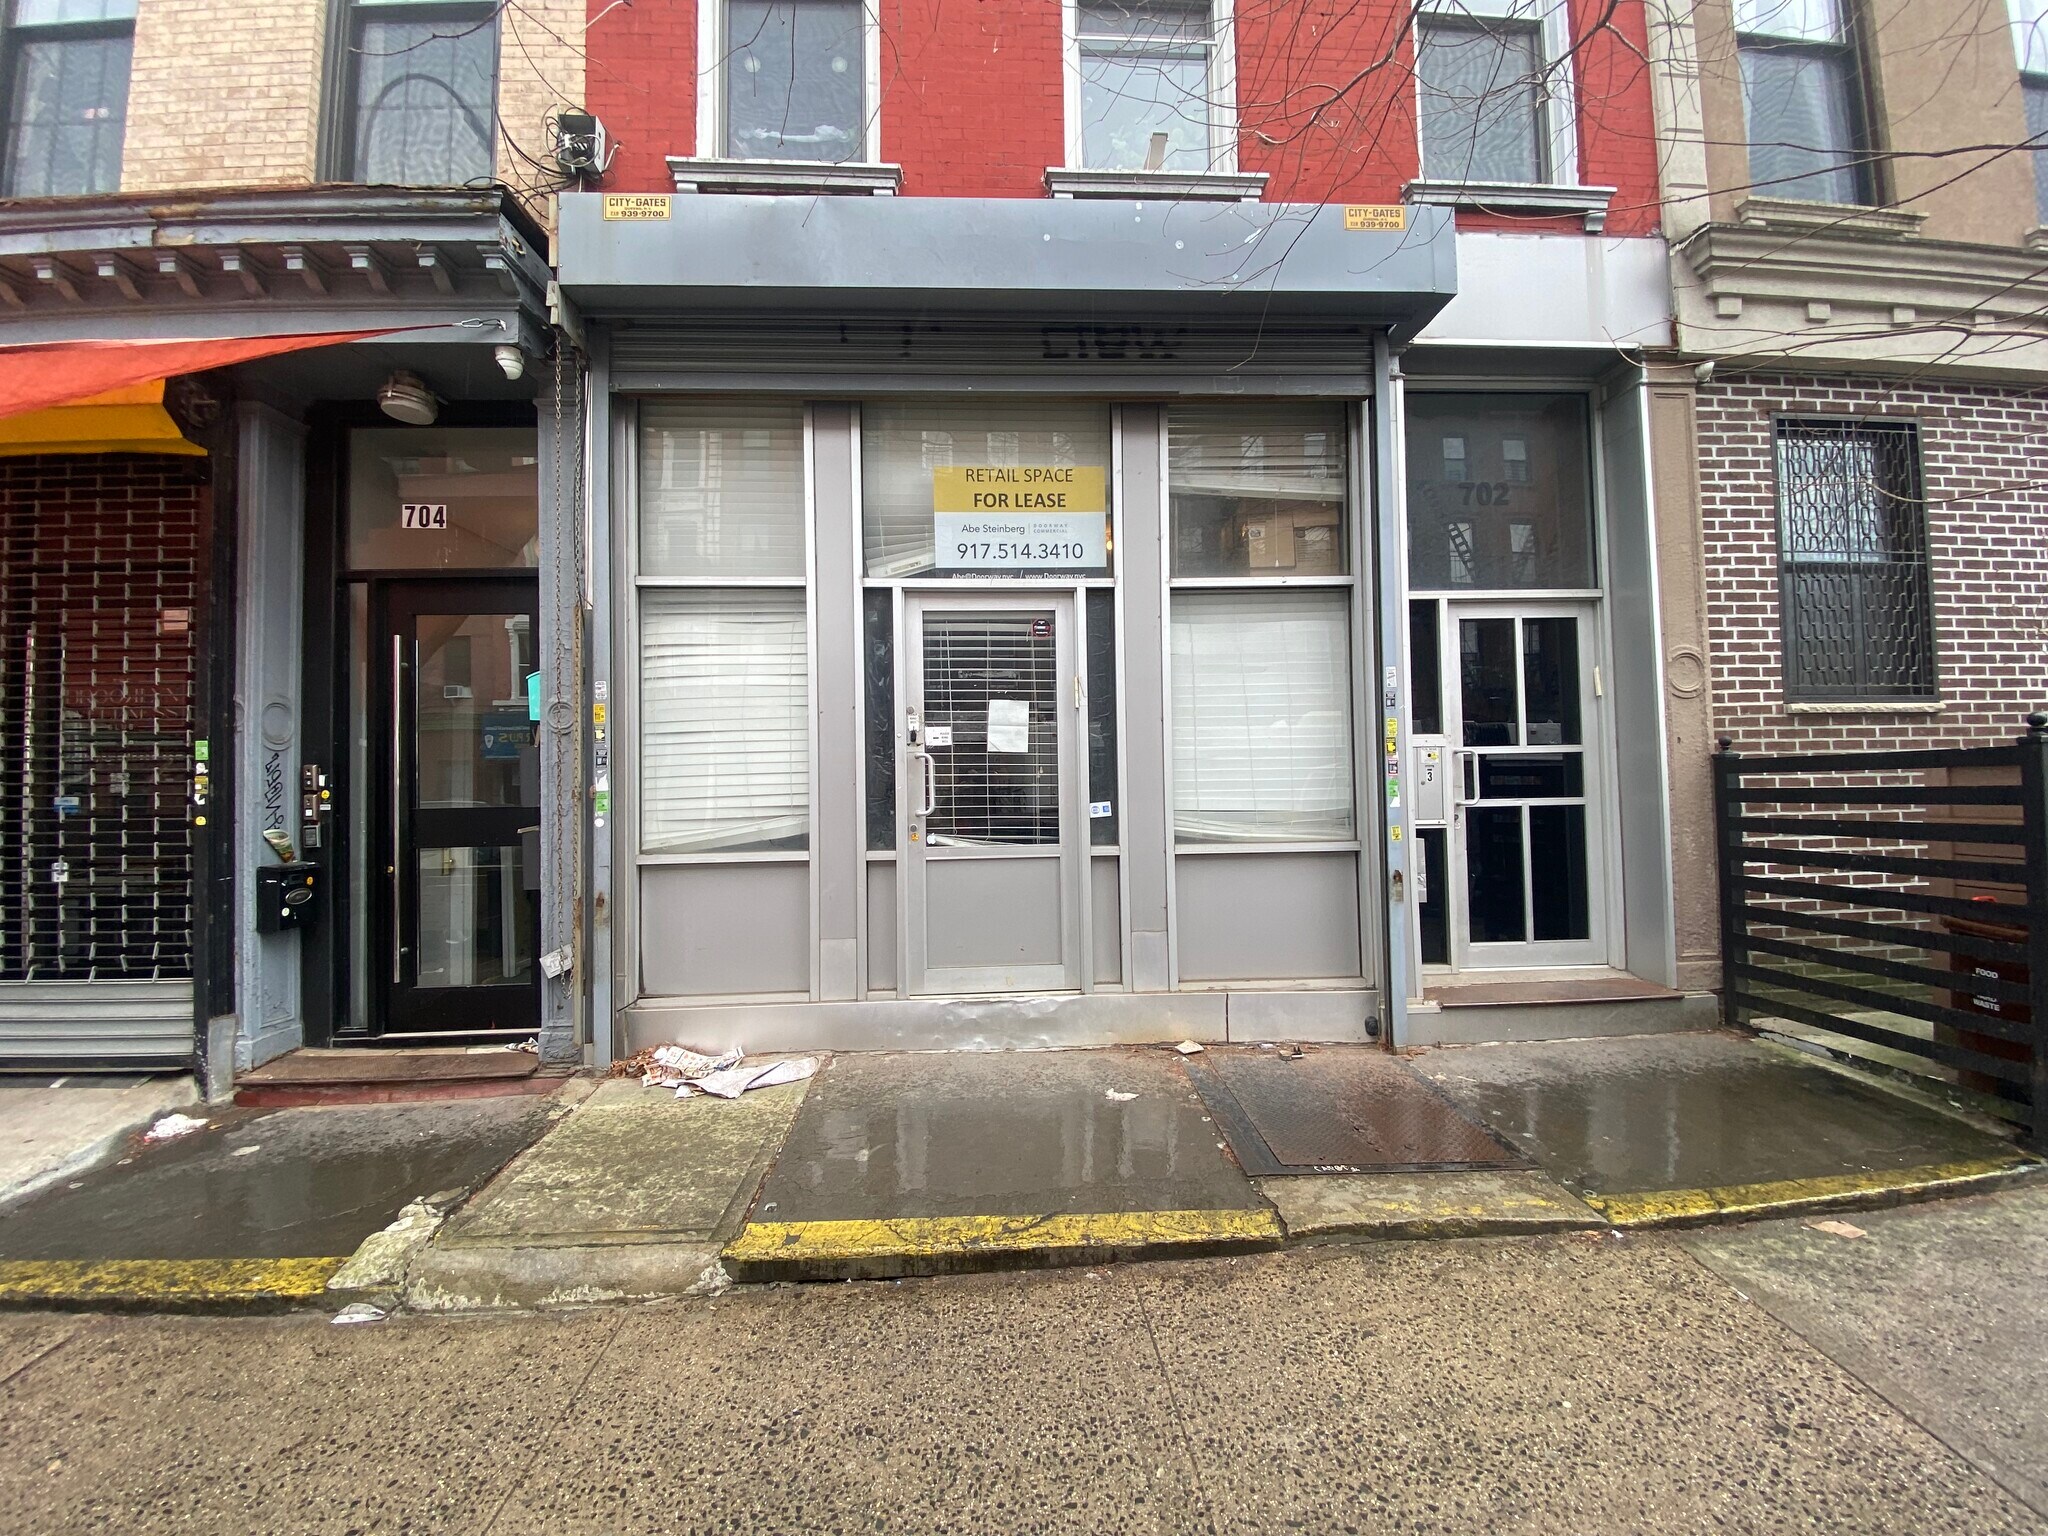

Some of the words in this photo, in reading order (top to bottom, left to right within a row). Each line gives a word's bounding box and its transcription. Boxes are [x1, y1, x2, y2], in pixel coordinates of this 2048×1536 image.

[609, 198, 666, 207] CITY-GATES
[1348, 208, 1401, 218] CITY-GATES
[965, 468, 1020, 483] RETAIL
[1024, 468, 1074, 483] SPACE
[974, 493, 1009, 508] FOR
[1015, 493, 1067, 508] LEASE
[1458, 481, 1511, 506] 702
[404, 505, 446, 528] 704
[961, 524, 981, 533] Abe
[982, 523, 1026, 535] Steinberg
[957, 543, 1084, 560] 917.514.3410
[1427, 771, 1433, 782] 3
[1975, 967, 1999, 979] FOOD
[1973, 998, 2001, 1012] WASTE
